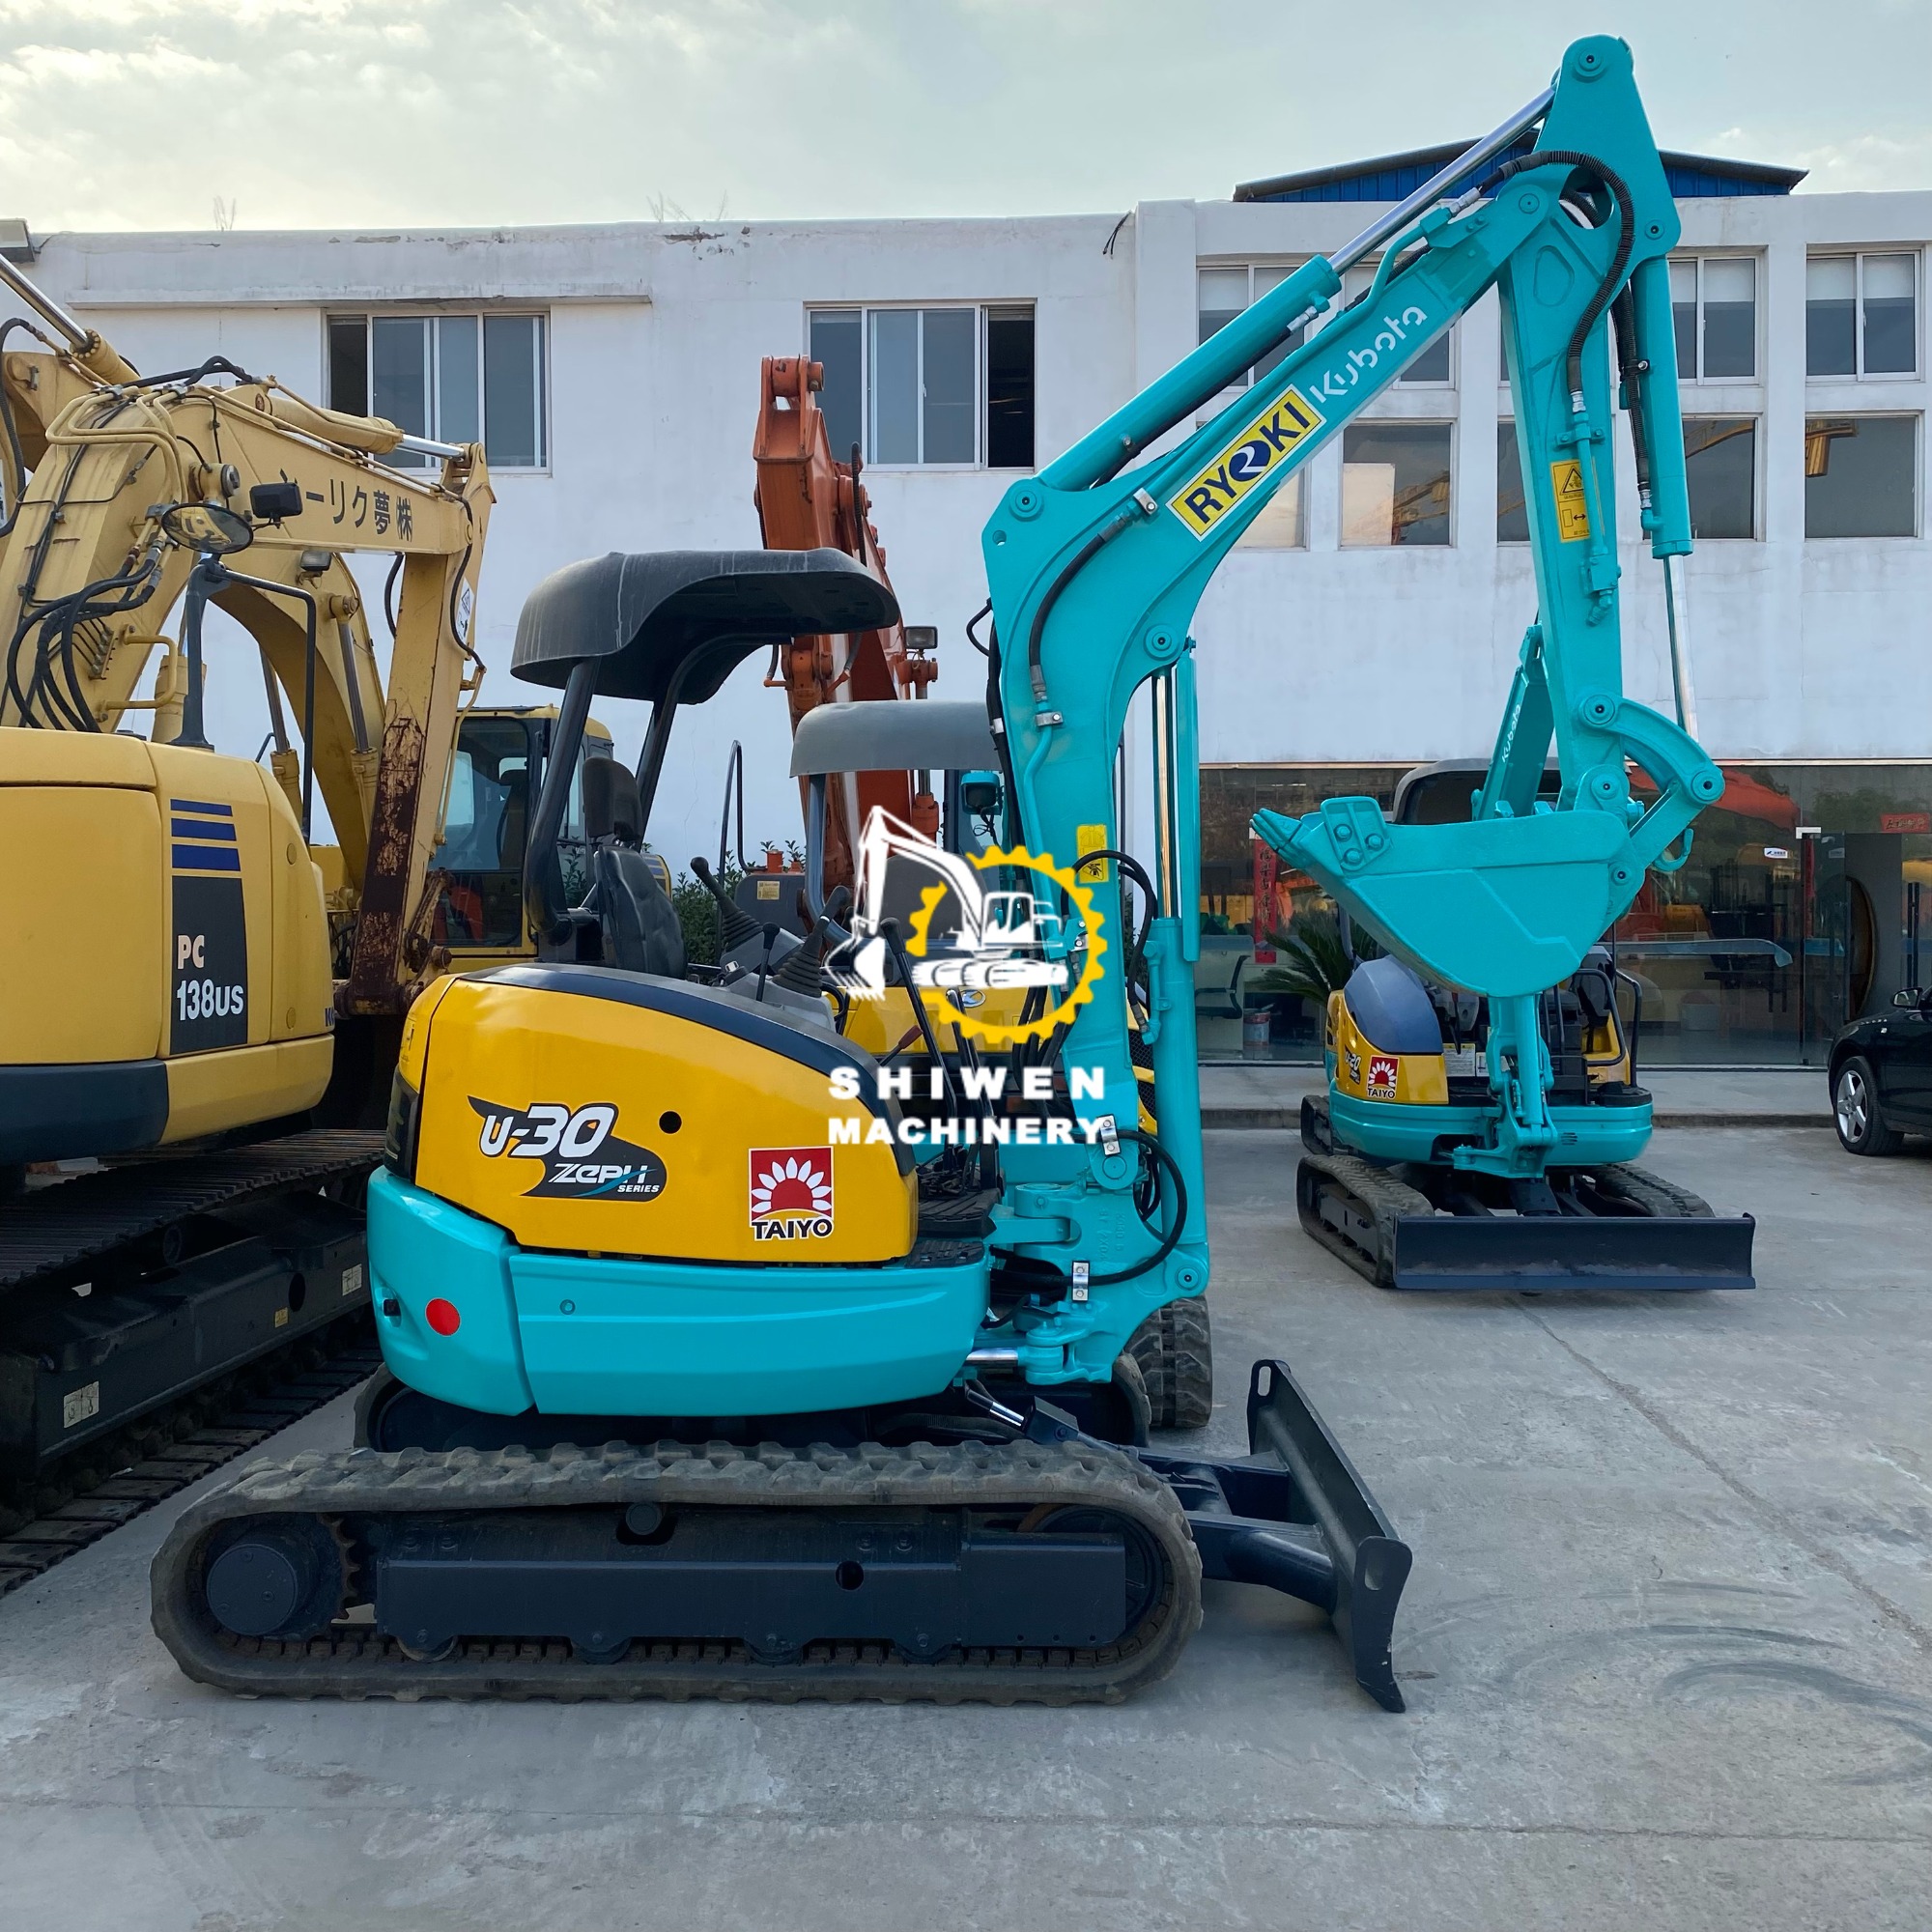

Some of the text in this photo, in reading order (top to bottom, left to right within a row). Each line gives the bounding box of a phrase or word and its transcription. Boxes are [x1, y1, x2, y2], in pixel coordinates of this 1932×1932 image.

[1309, 306, 1428, 404] Kubota
[1184, 401, 1311, 525] RYOKI
[1501, 703, 1521, 763] Kubota
[177, 934, 205, 970] PC
[177, 979, 244, 1021] 138US
[1367, 1088, 1395, 1098] TAIYO
[480, 1105, 616, 1158] U-30
[617, 1184, 660, 1193] SERIES
[752, 1218, 833, 1239] TAIYO
